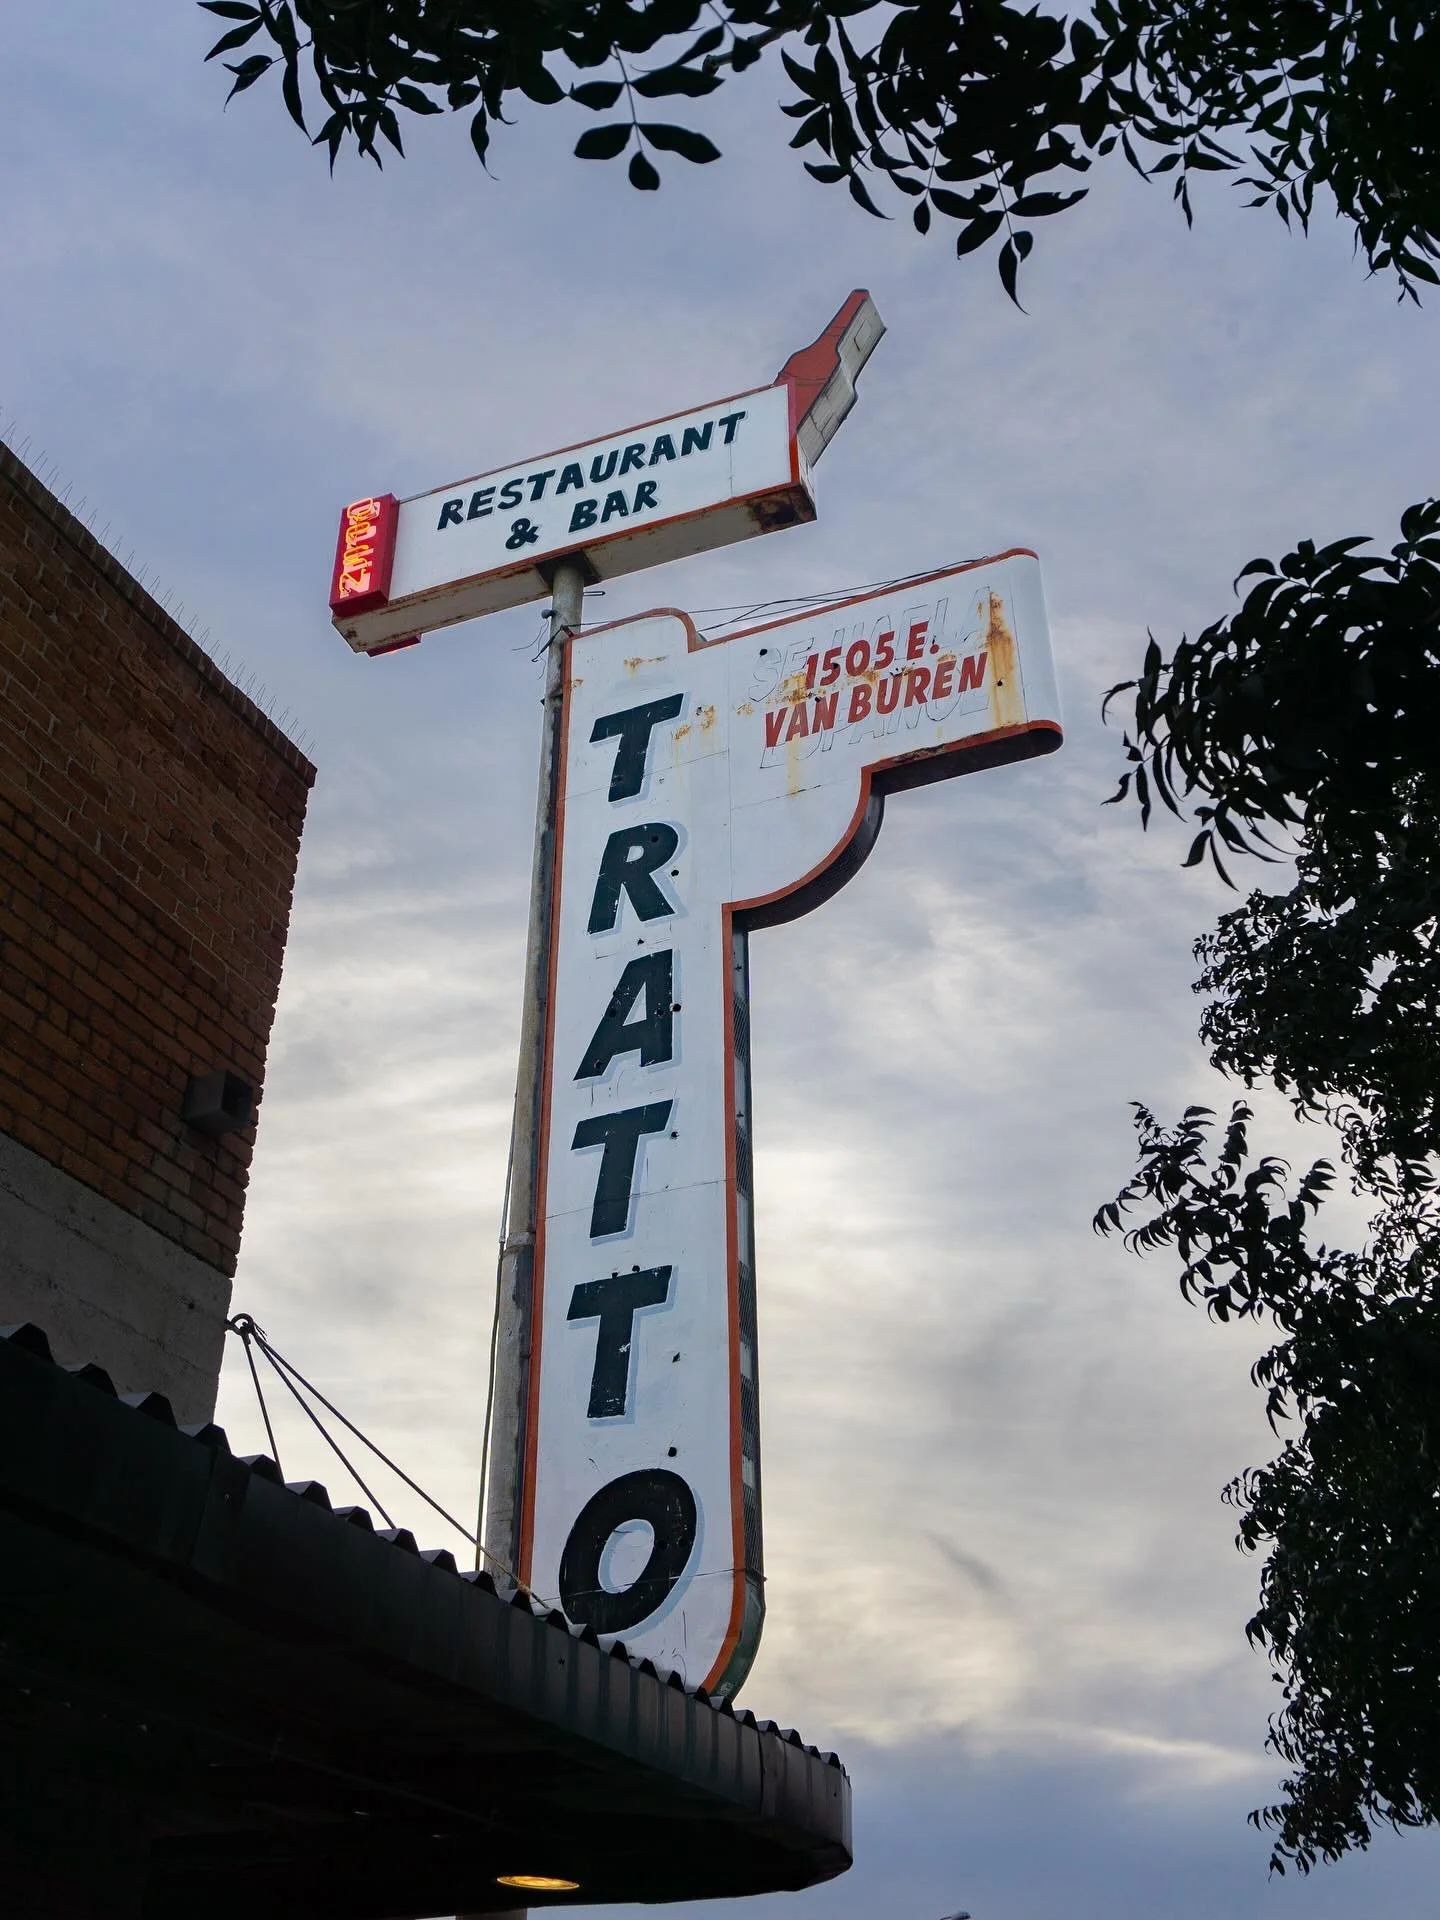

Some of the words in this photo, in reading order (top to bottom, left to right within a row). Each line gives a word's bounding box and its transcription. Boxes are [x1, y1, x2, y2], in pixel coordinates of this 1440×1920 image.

[437, 411, 746, 531] RESTAURANT
[504, 517, 540, 550] &
[568, 480, 659, 534] BAR
[765, 691, 840, 749] VAN
[847, 651, 988, 724] BUREN
[804, 630, 896, 690] 1505
[559, 692, 698, 1635] TRATTO
